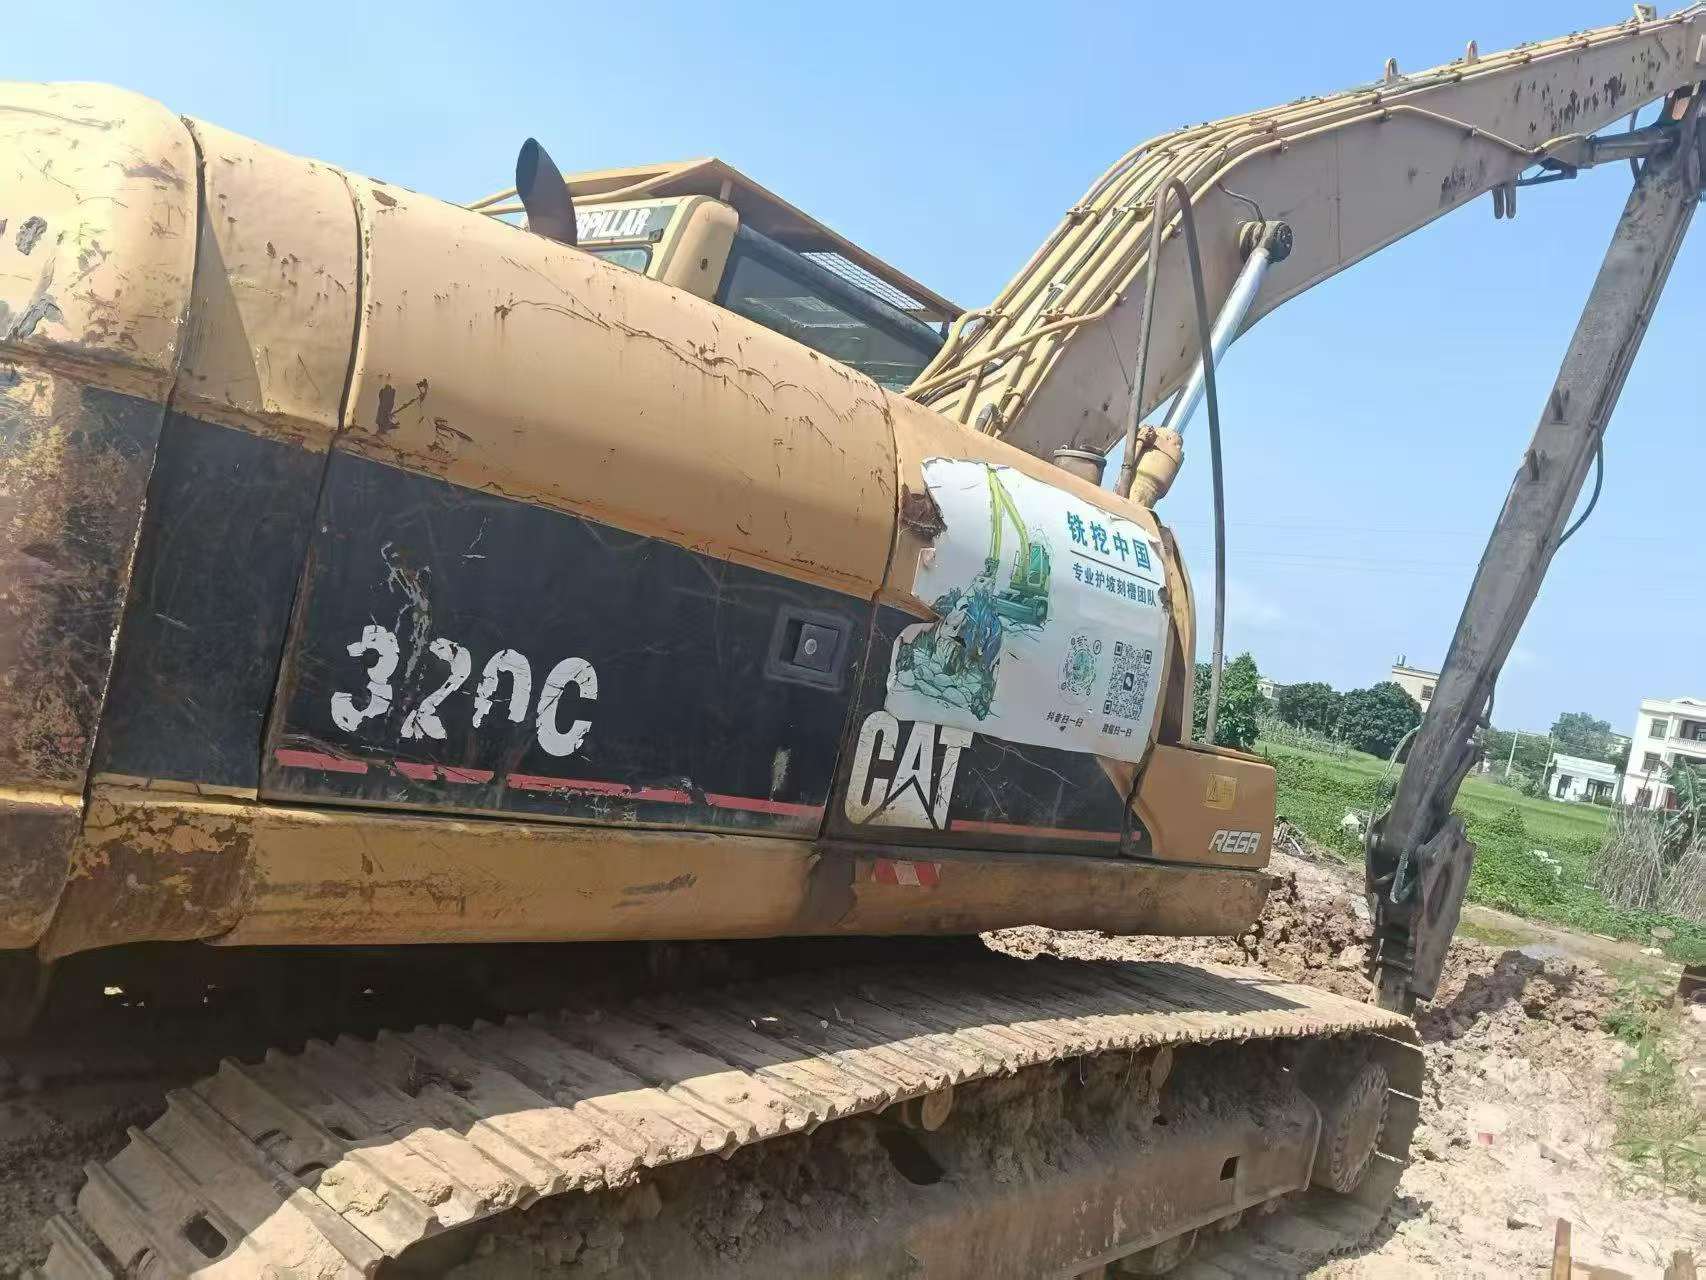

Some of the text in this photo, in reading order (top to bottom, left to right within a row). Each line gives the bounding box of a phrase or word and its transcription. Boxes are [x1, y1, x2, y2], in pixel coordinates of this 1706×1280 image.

[1067, 511, 1151, 572] 铣挖中国
[1073, 562, 1157, 607] 专业护坡刻槽团队
[845, 711, 973, 831] CAT
